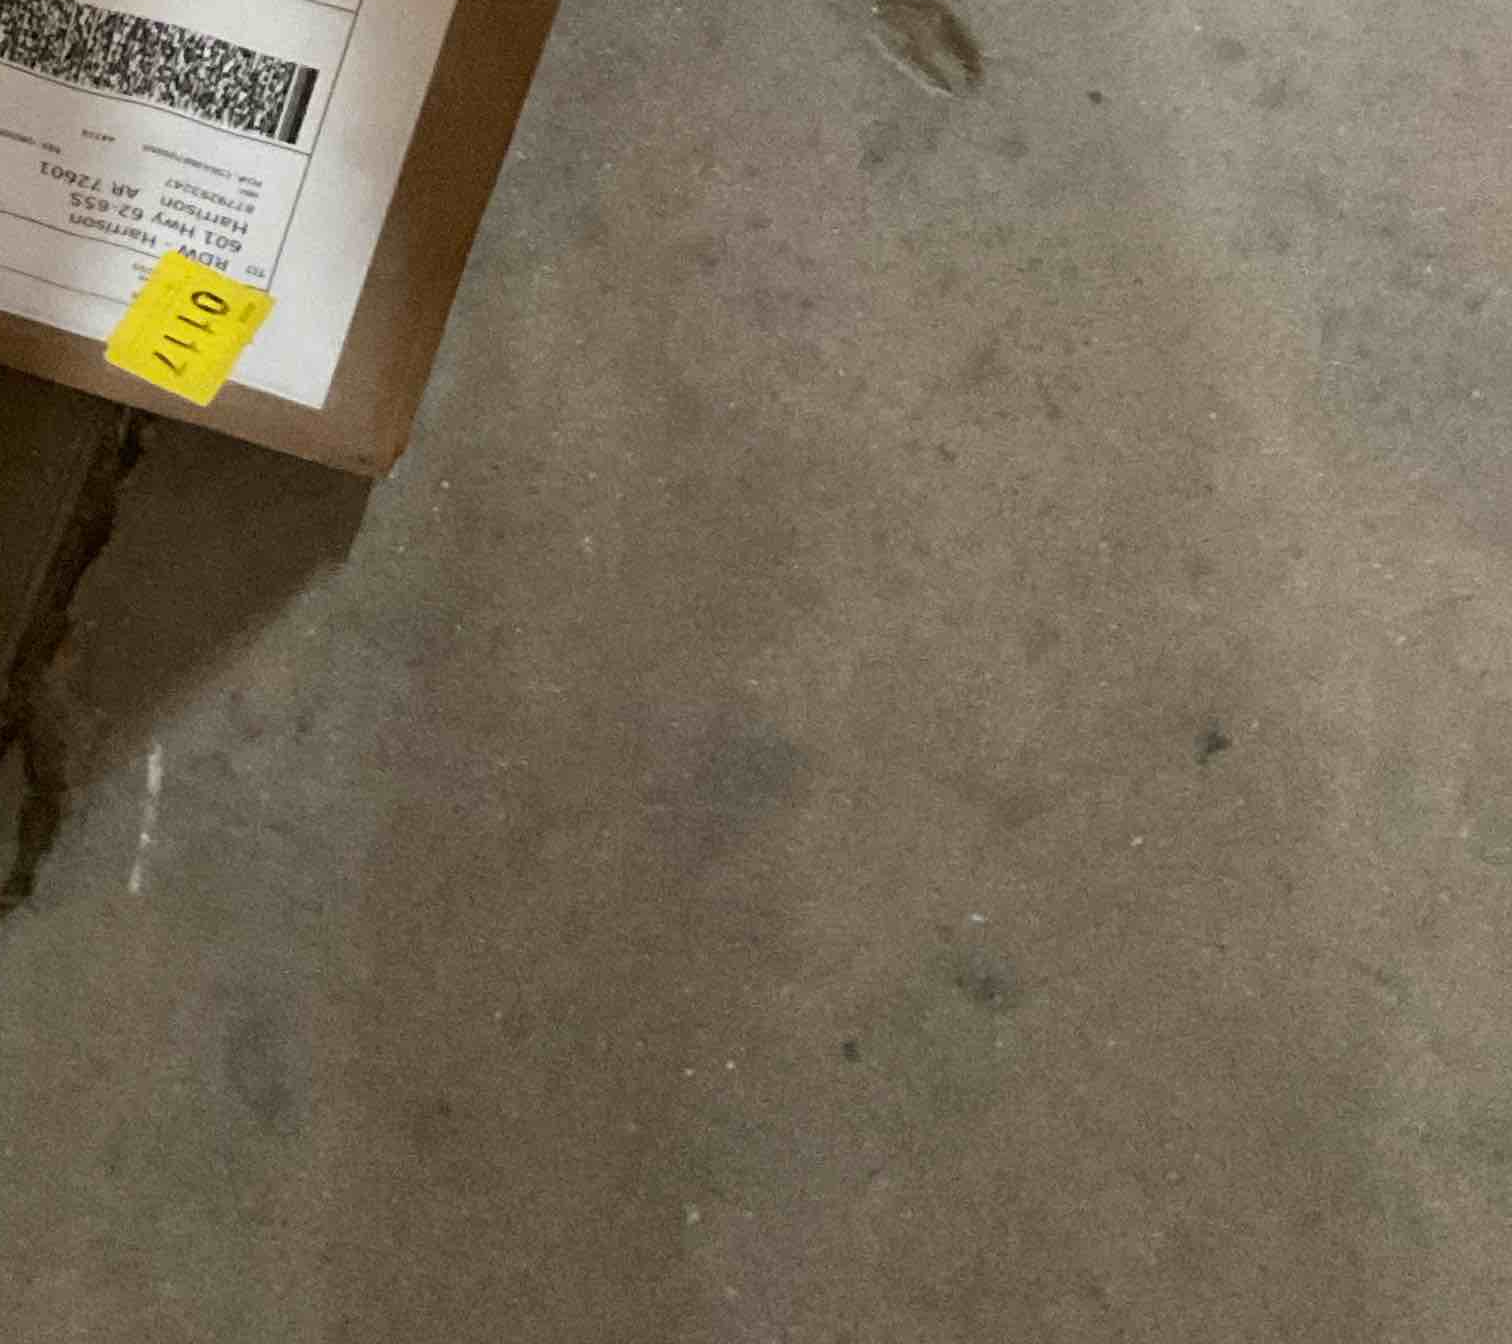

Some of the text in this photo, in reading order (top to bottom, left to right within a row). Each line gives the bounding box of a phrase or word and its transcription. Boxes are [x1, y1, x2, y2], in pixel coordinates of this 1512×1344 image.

[38, 161, 101, 190] 72601
[112, 181, 139, 198] AR
[68, 213, 155, 245] Harrison
[150, 212, 195, 238] Hwy
[160, 196, 248, 234] Harrison
[202, 231, 242, 253] 601
[153, 291, 227, 375] 0117
